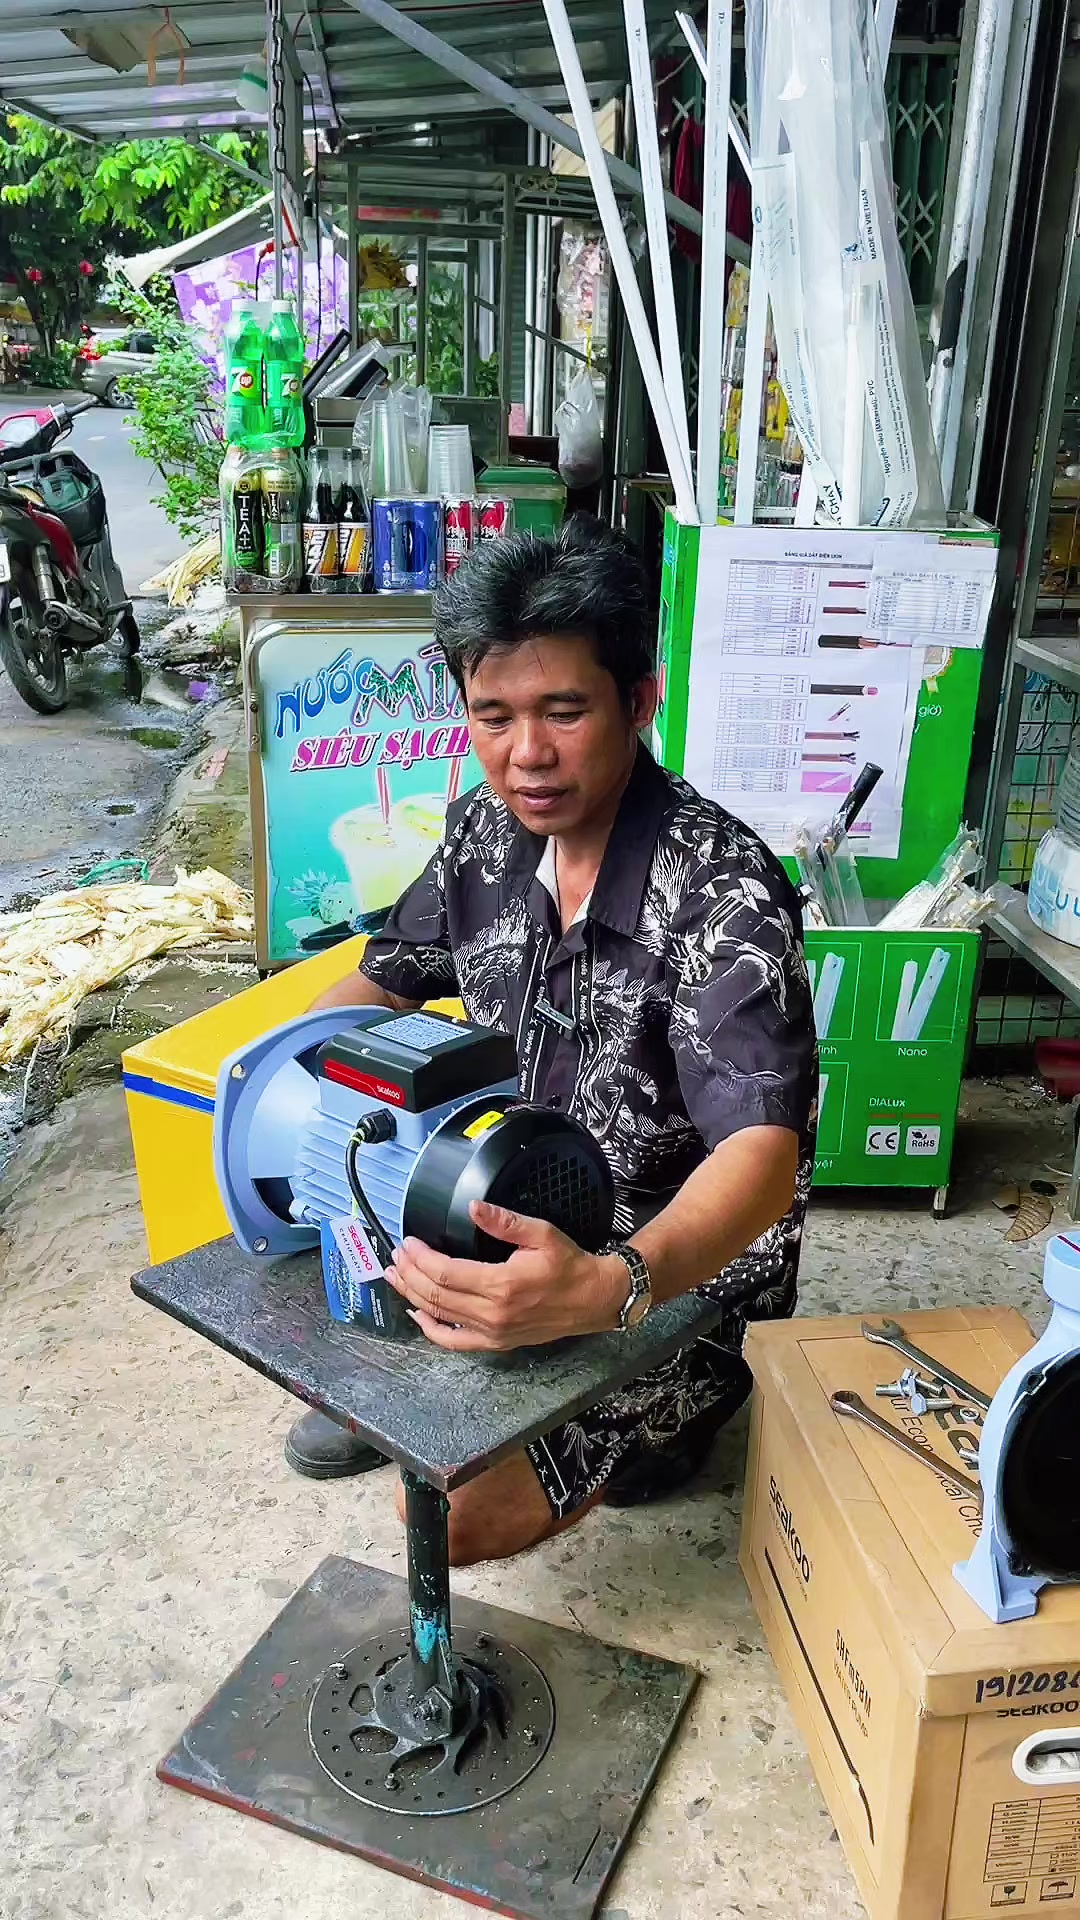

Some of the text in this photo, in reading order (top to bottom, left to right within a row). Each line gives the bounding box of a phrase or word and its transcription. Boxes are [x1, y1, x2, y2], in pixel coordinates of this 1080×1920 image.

[861, 188, 872, 225] VIETNAM
[868, 239, 877, 259] MADE
[866, 379, 874, 396] PVC
[290, 727, 471, 773] SIÊU SẠCH
[898, 1047, 928, 1056] Nano
[869, 1097, 906, 1107] DIALUX
[911, 1139, 935, 1148] RoHS
[340, 1228, 362, 1273] CERTIFICATE
